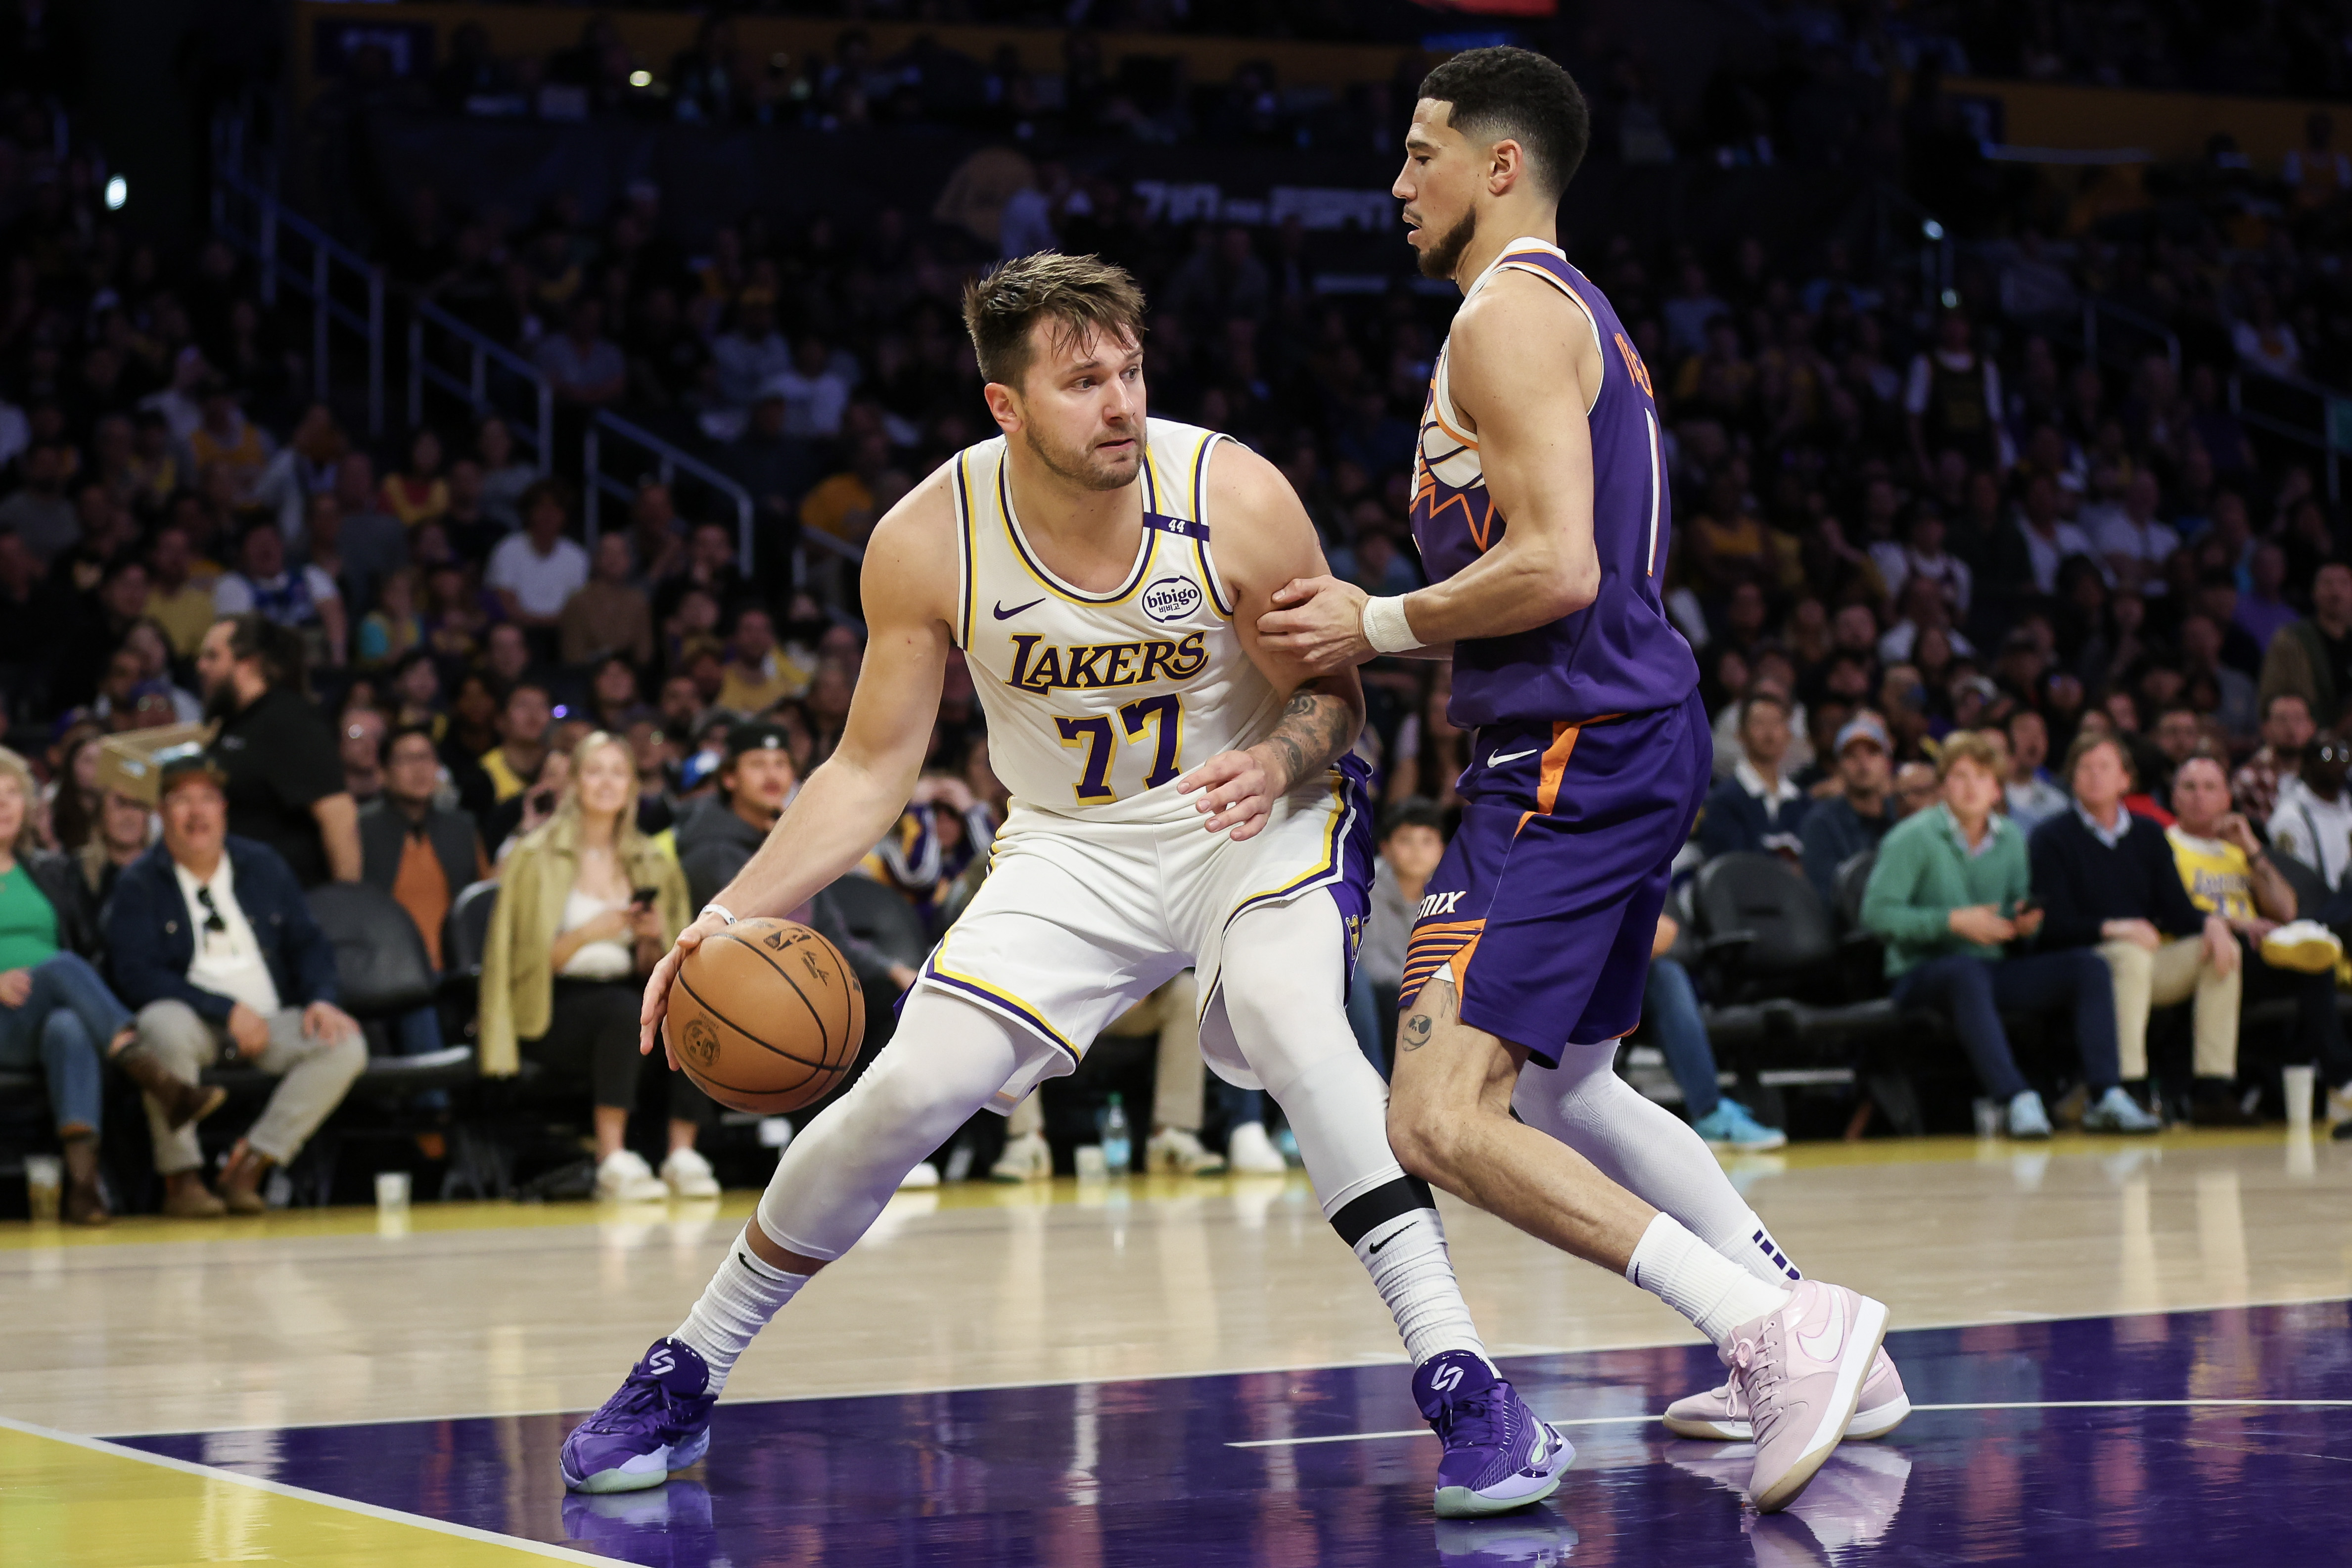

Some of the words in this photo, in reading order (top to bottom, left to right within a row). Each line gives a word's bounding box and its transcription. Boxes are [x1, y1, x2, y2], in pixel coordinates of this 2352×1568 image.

[1168, 519, 1186, 533] 44
[1147, 589, 1198, 608] bibigo
[1159, 603, 1180, 613] 비비고
[1003, 630, 1210, 696] LAKERS
[1051, 693, 1186, 806] 77
